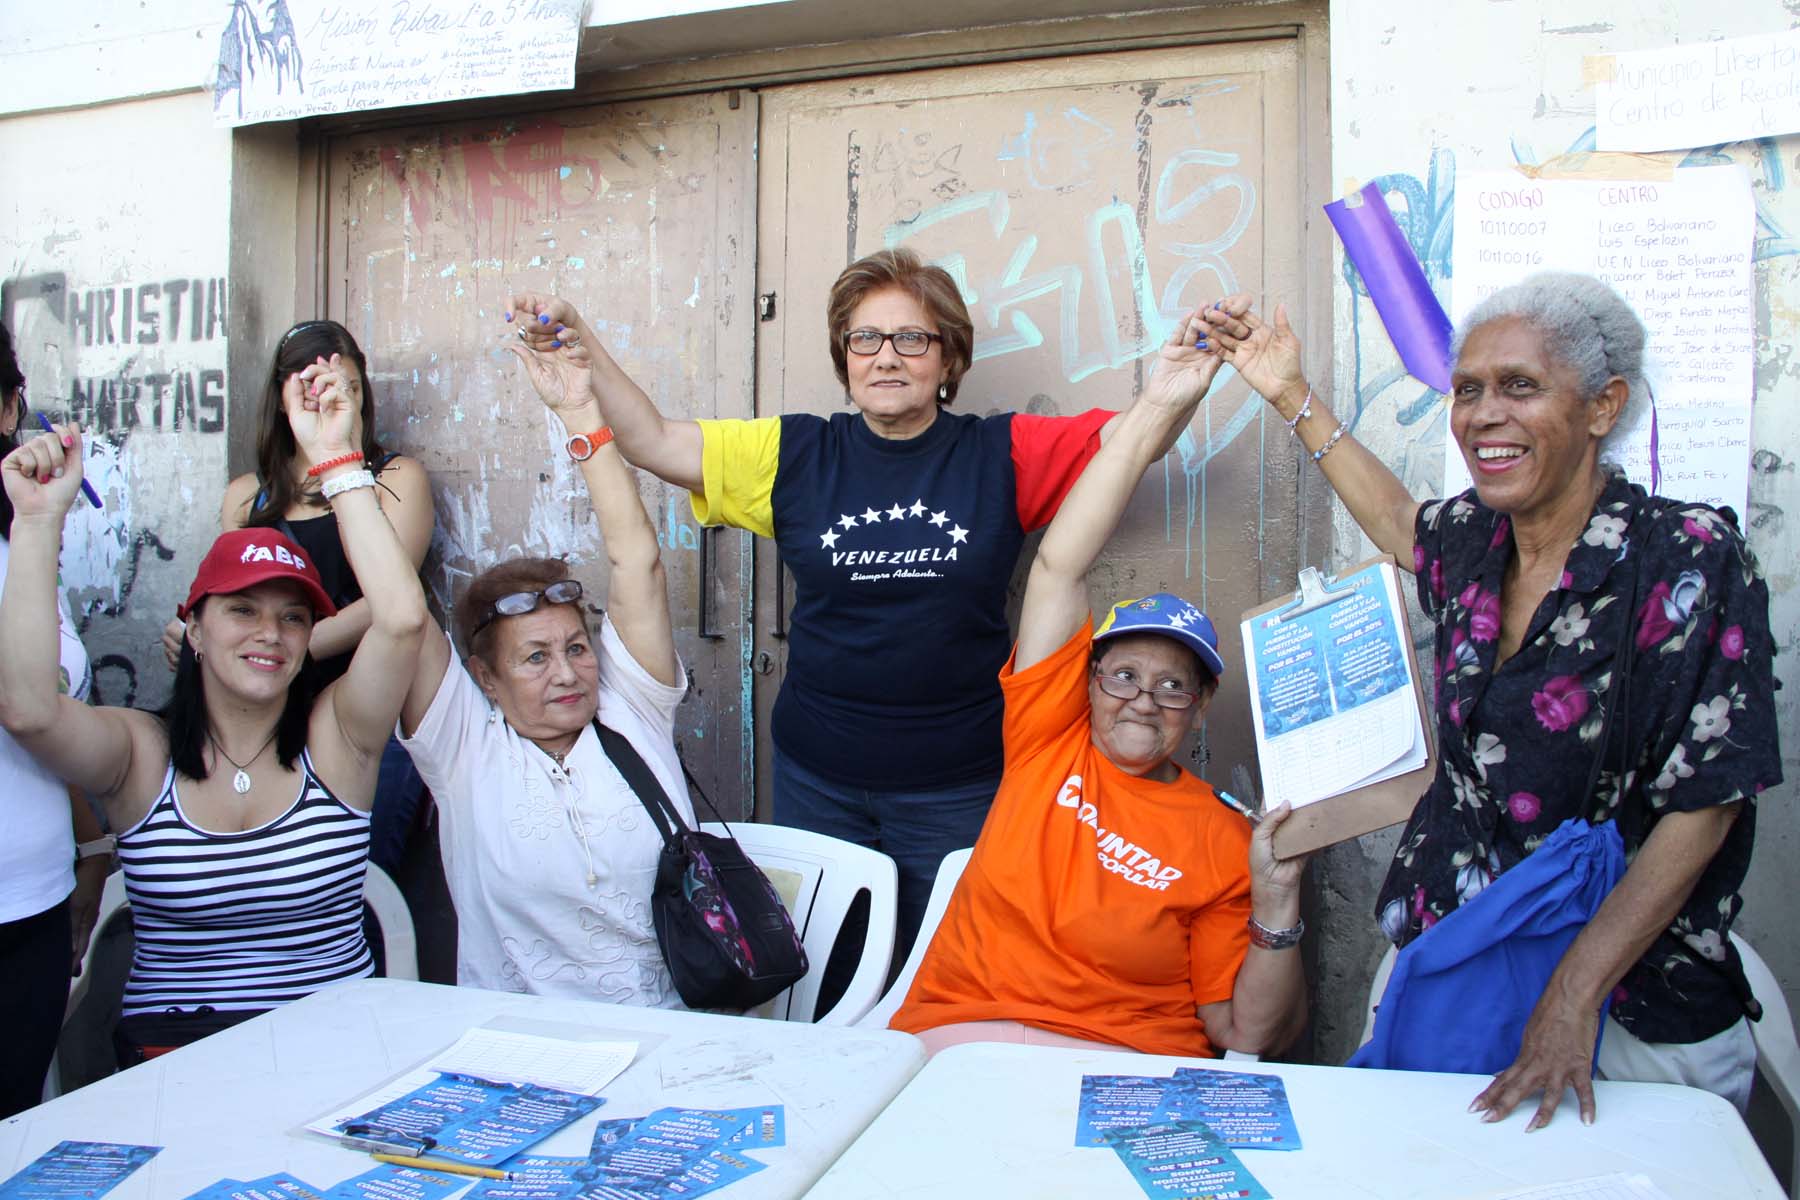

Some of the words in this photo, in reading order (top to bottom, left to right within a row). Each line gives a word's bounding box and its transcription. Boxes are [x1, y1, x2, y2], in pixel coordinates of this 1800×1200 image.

[1714, 42, 1800, 77] Liberta
[1609, 90, 1684, 126] Centro
[1701, 82, 1728, 112] de
[1478, 187, 1544, 212] CODIGO
[1598, 186, 1658, 207] CENTRO
[1480, 219, 1547, 236] 10110007
[1598, 218, 1634, 233] Liceo
[1598, 237, 1623, 248] Luis
[1479, 248, 1543, 265] 10110016
[1640, 256, 1669, 269] Liceo
[1678, 253, 1745, 268] Bolivariano
[1660, 454, 1686, 465] Julio
[832, 547, 958, 567] VENEZUELA
[850, 572, 891, 582] Siempre
